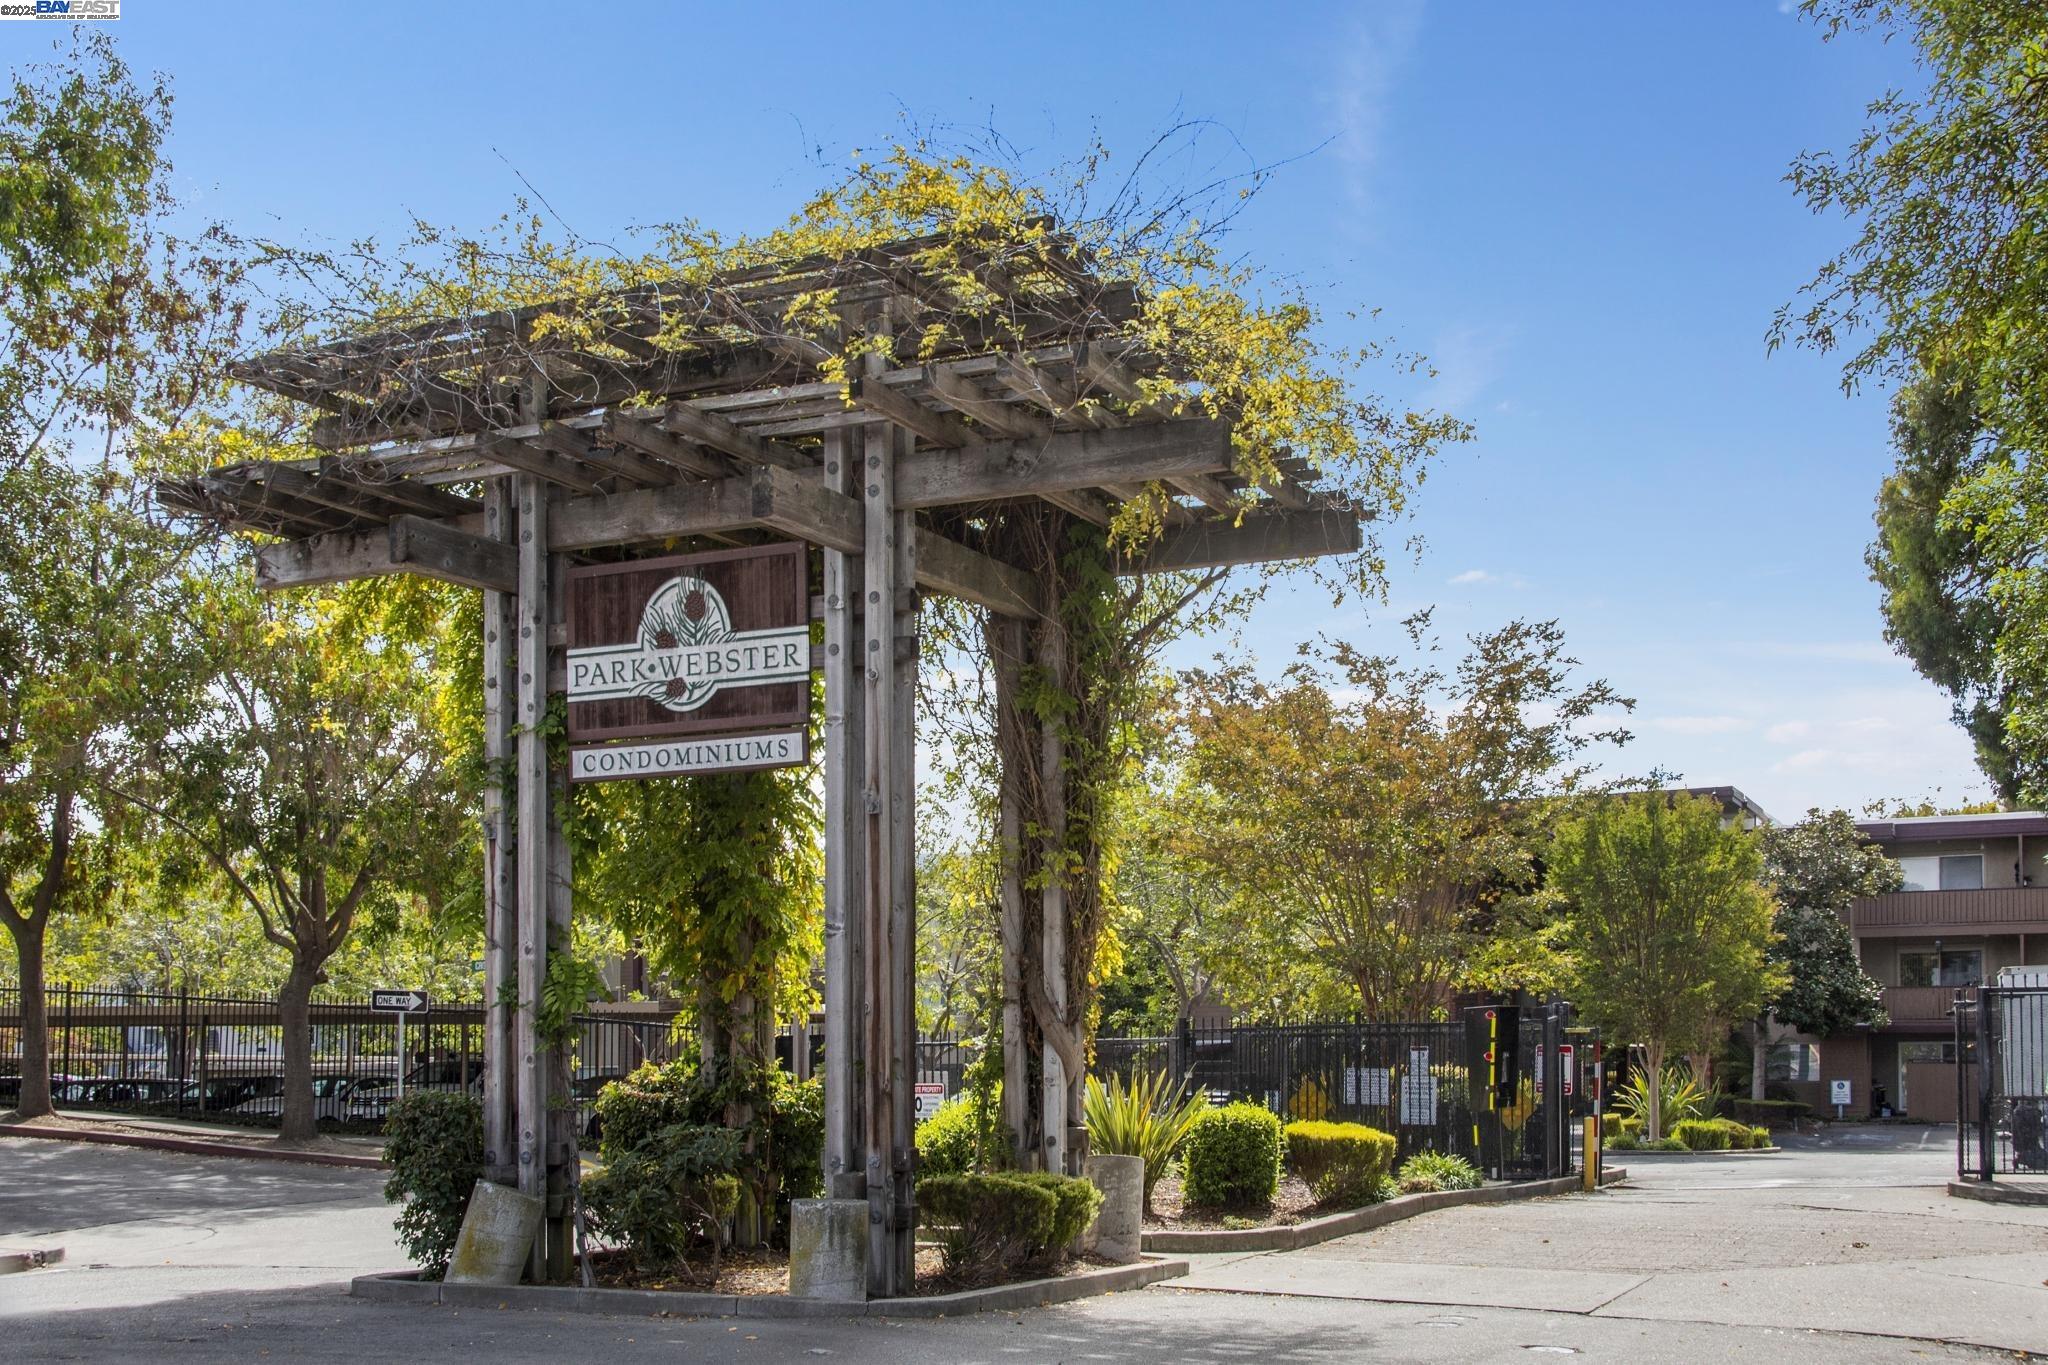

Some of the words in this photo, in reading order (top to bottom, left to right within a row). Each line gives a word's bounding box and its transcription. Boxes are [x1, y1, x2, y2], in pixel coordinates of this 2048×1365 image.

[574, 658, 647, 687] PARK
[658, 643, 802, 679] WEBSTER
[583, 739, 789, 773] CONDOMINIUMS
[378, 996, 393, 1005] ONE
[395, 997, 411, 1006] WAY
